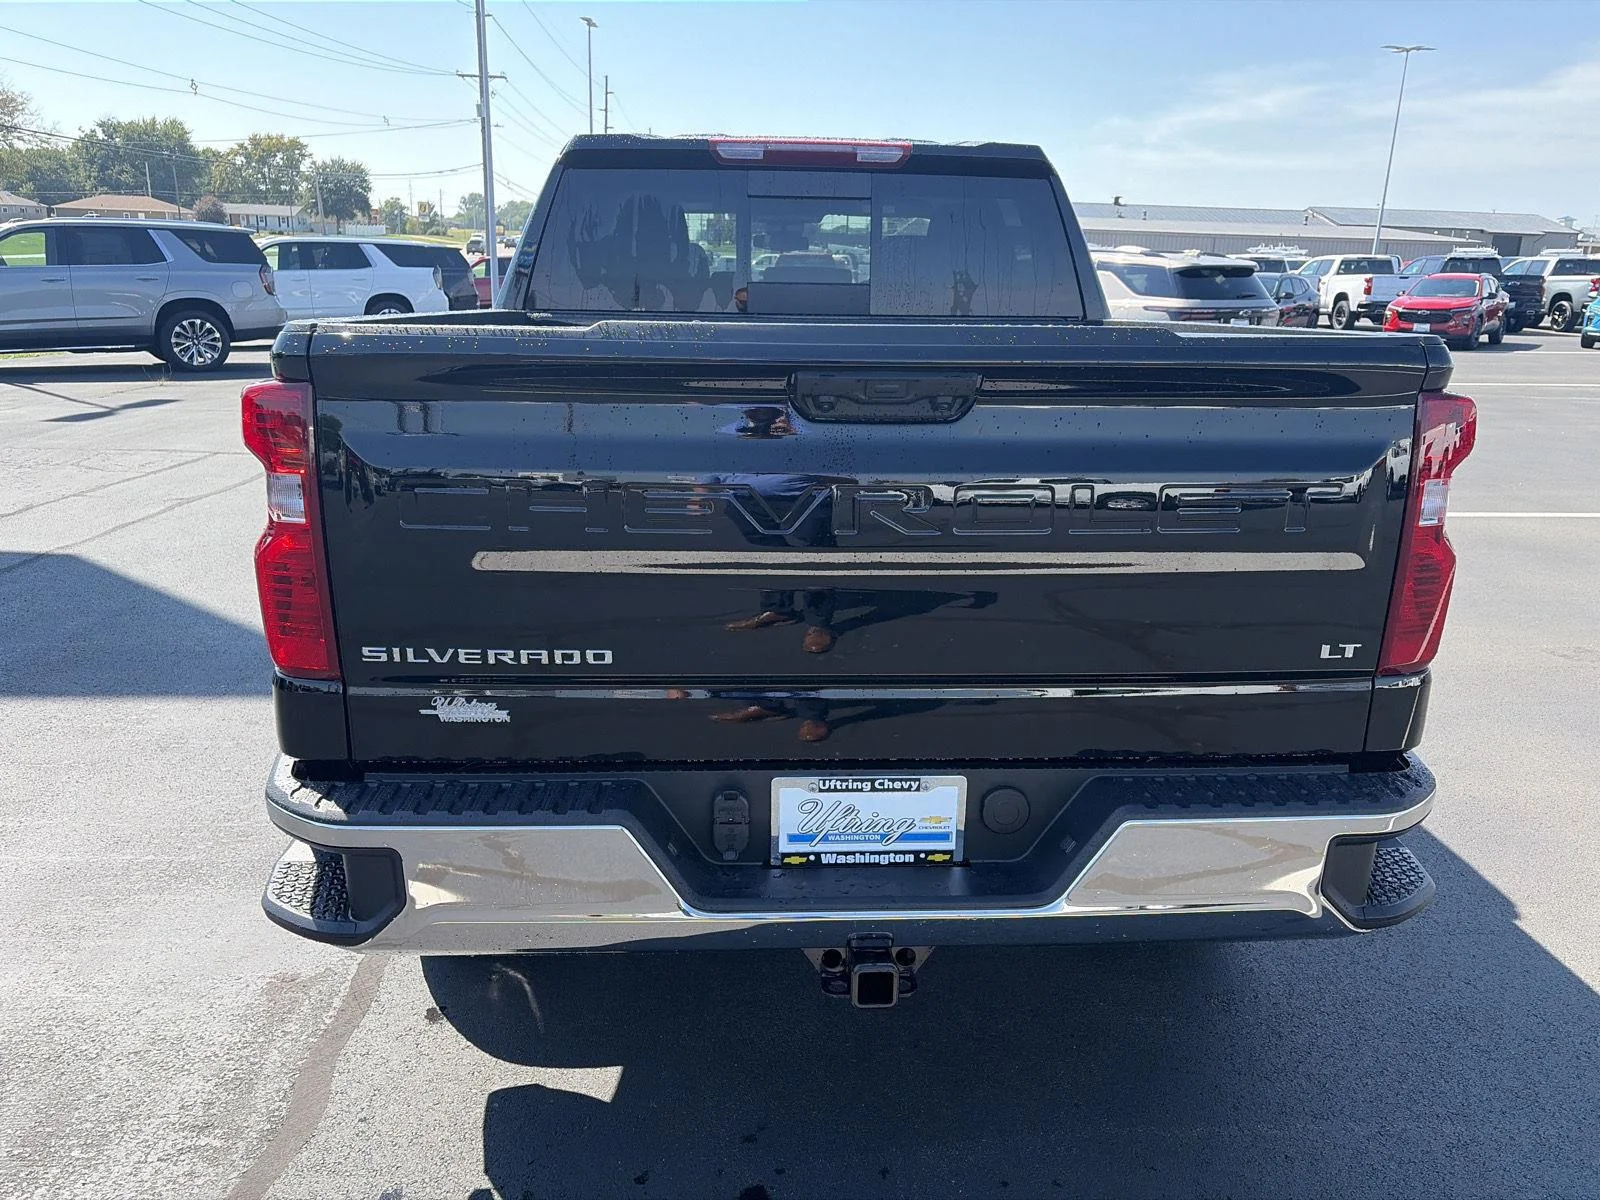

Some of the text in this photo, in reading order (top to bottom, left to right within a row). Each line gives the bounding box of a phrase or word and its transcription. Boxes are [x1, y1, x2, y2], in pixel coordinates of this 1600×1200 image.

[399, 481, 1345, 536] CHEVROLET
[361, 646, 613, 665] SILVERADO
[1320, 643, 1362, 659] LT
[818, 779, 919, 791] Uftring Chevy
[797, 798, 917, 847] Uftring
[827, 833, 881, 841] WASHINGTON
[820, 852, 915, 865] Washington
